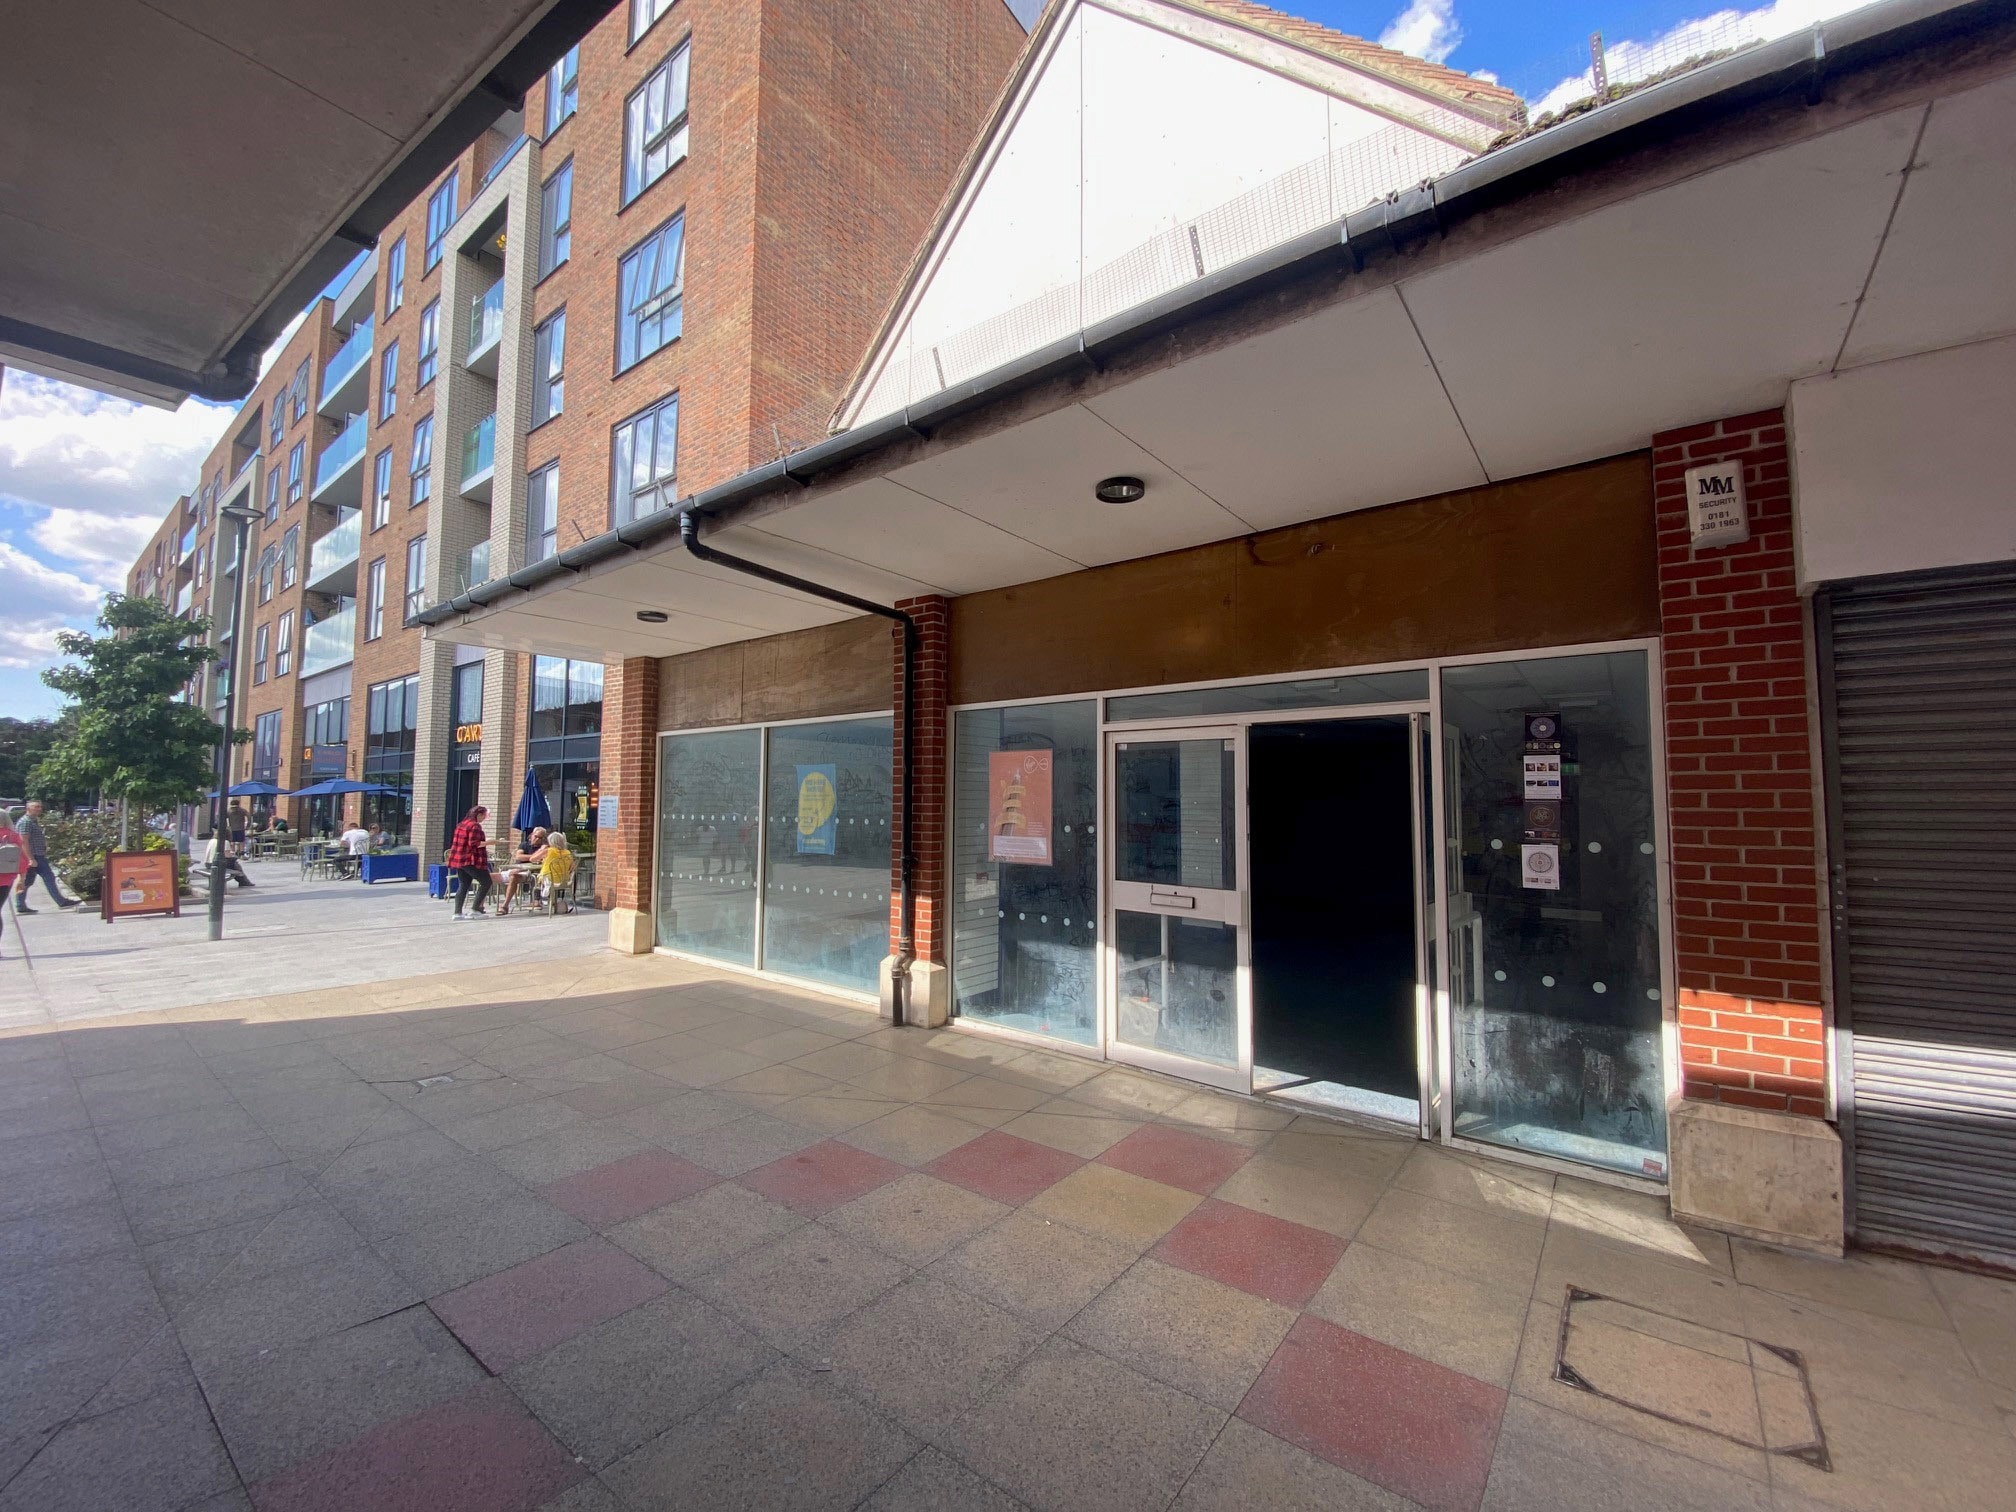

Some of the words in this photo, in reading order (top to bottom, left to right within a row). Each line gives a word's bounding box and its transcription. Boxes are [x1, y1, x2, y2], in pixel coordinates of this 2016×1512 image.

[1698, 476, 1734, 495] MM
[1699, 497, 1737, 508] SECURITY
[1708, 511, 1729, 520] 0181
[1700, 521, 1716, 531] 330
